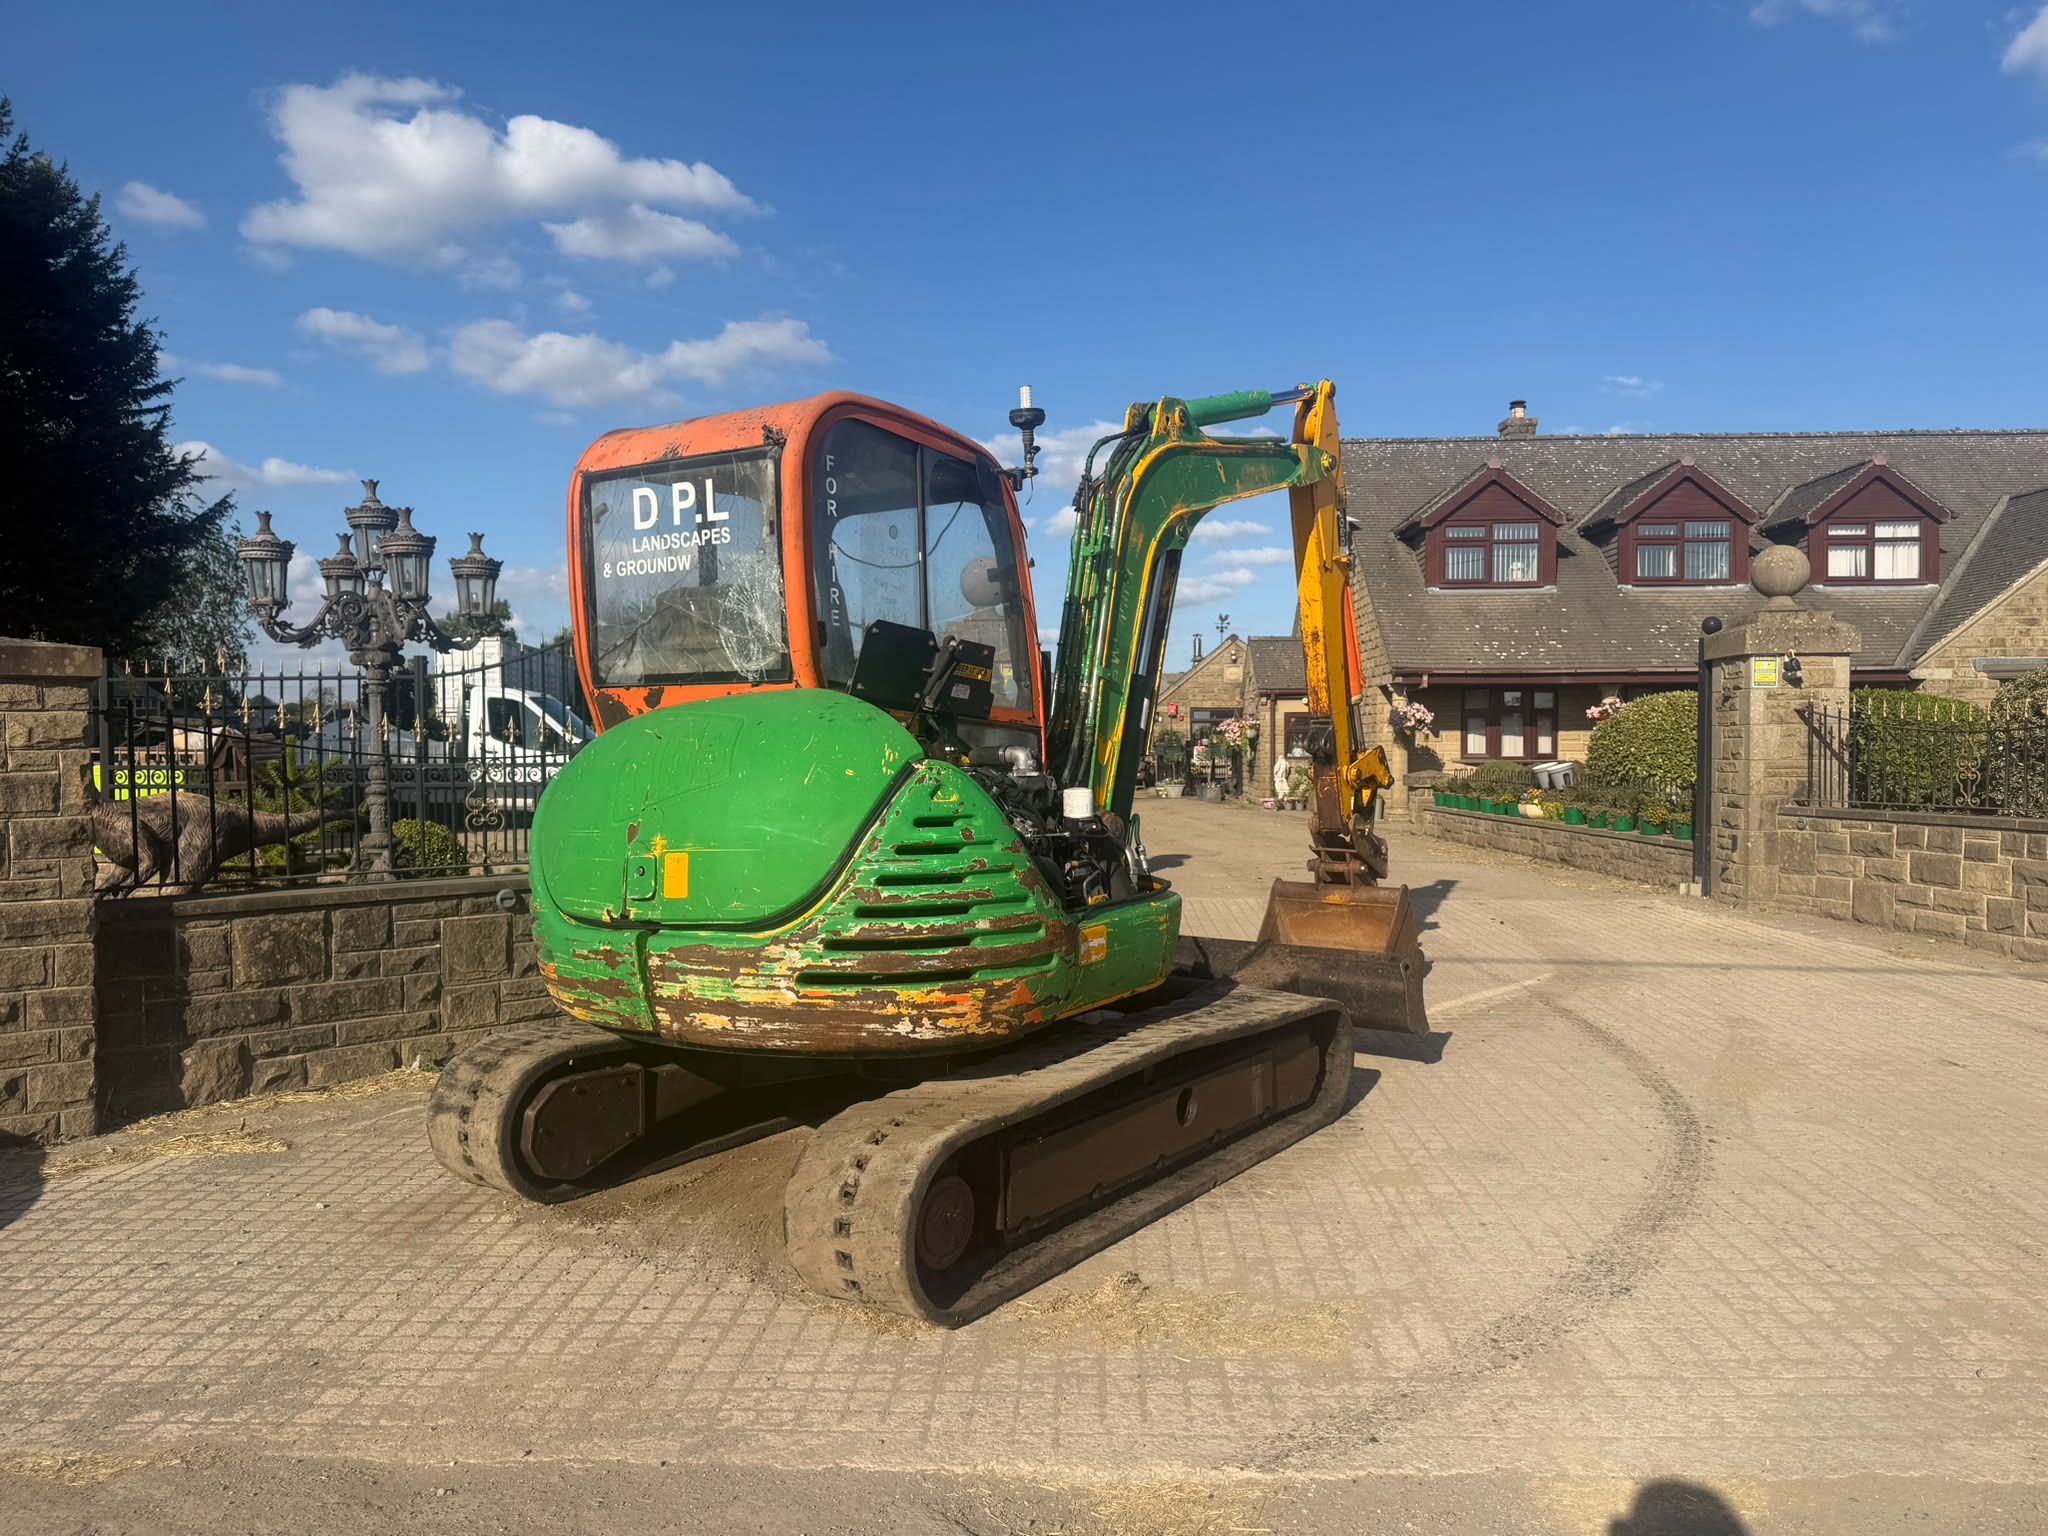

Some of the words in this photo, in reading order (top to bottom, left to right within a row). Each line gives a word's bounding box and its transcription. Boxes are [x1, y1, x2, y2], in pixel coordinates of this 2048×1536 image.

[825, 454, 838, 518] FOR
[632, 526, 731, 554] LANDSCAPES
[603, 562, 613, 578] &
[616, 554, 692, 577] GROUNDW
[828, 543, 841, 627] HIRE
